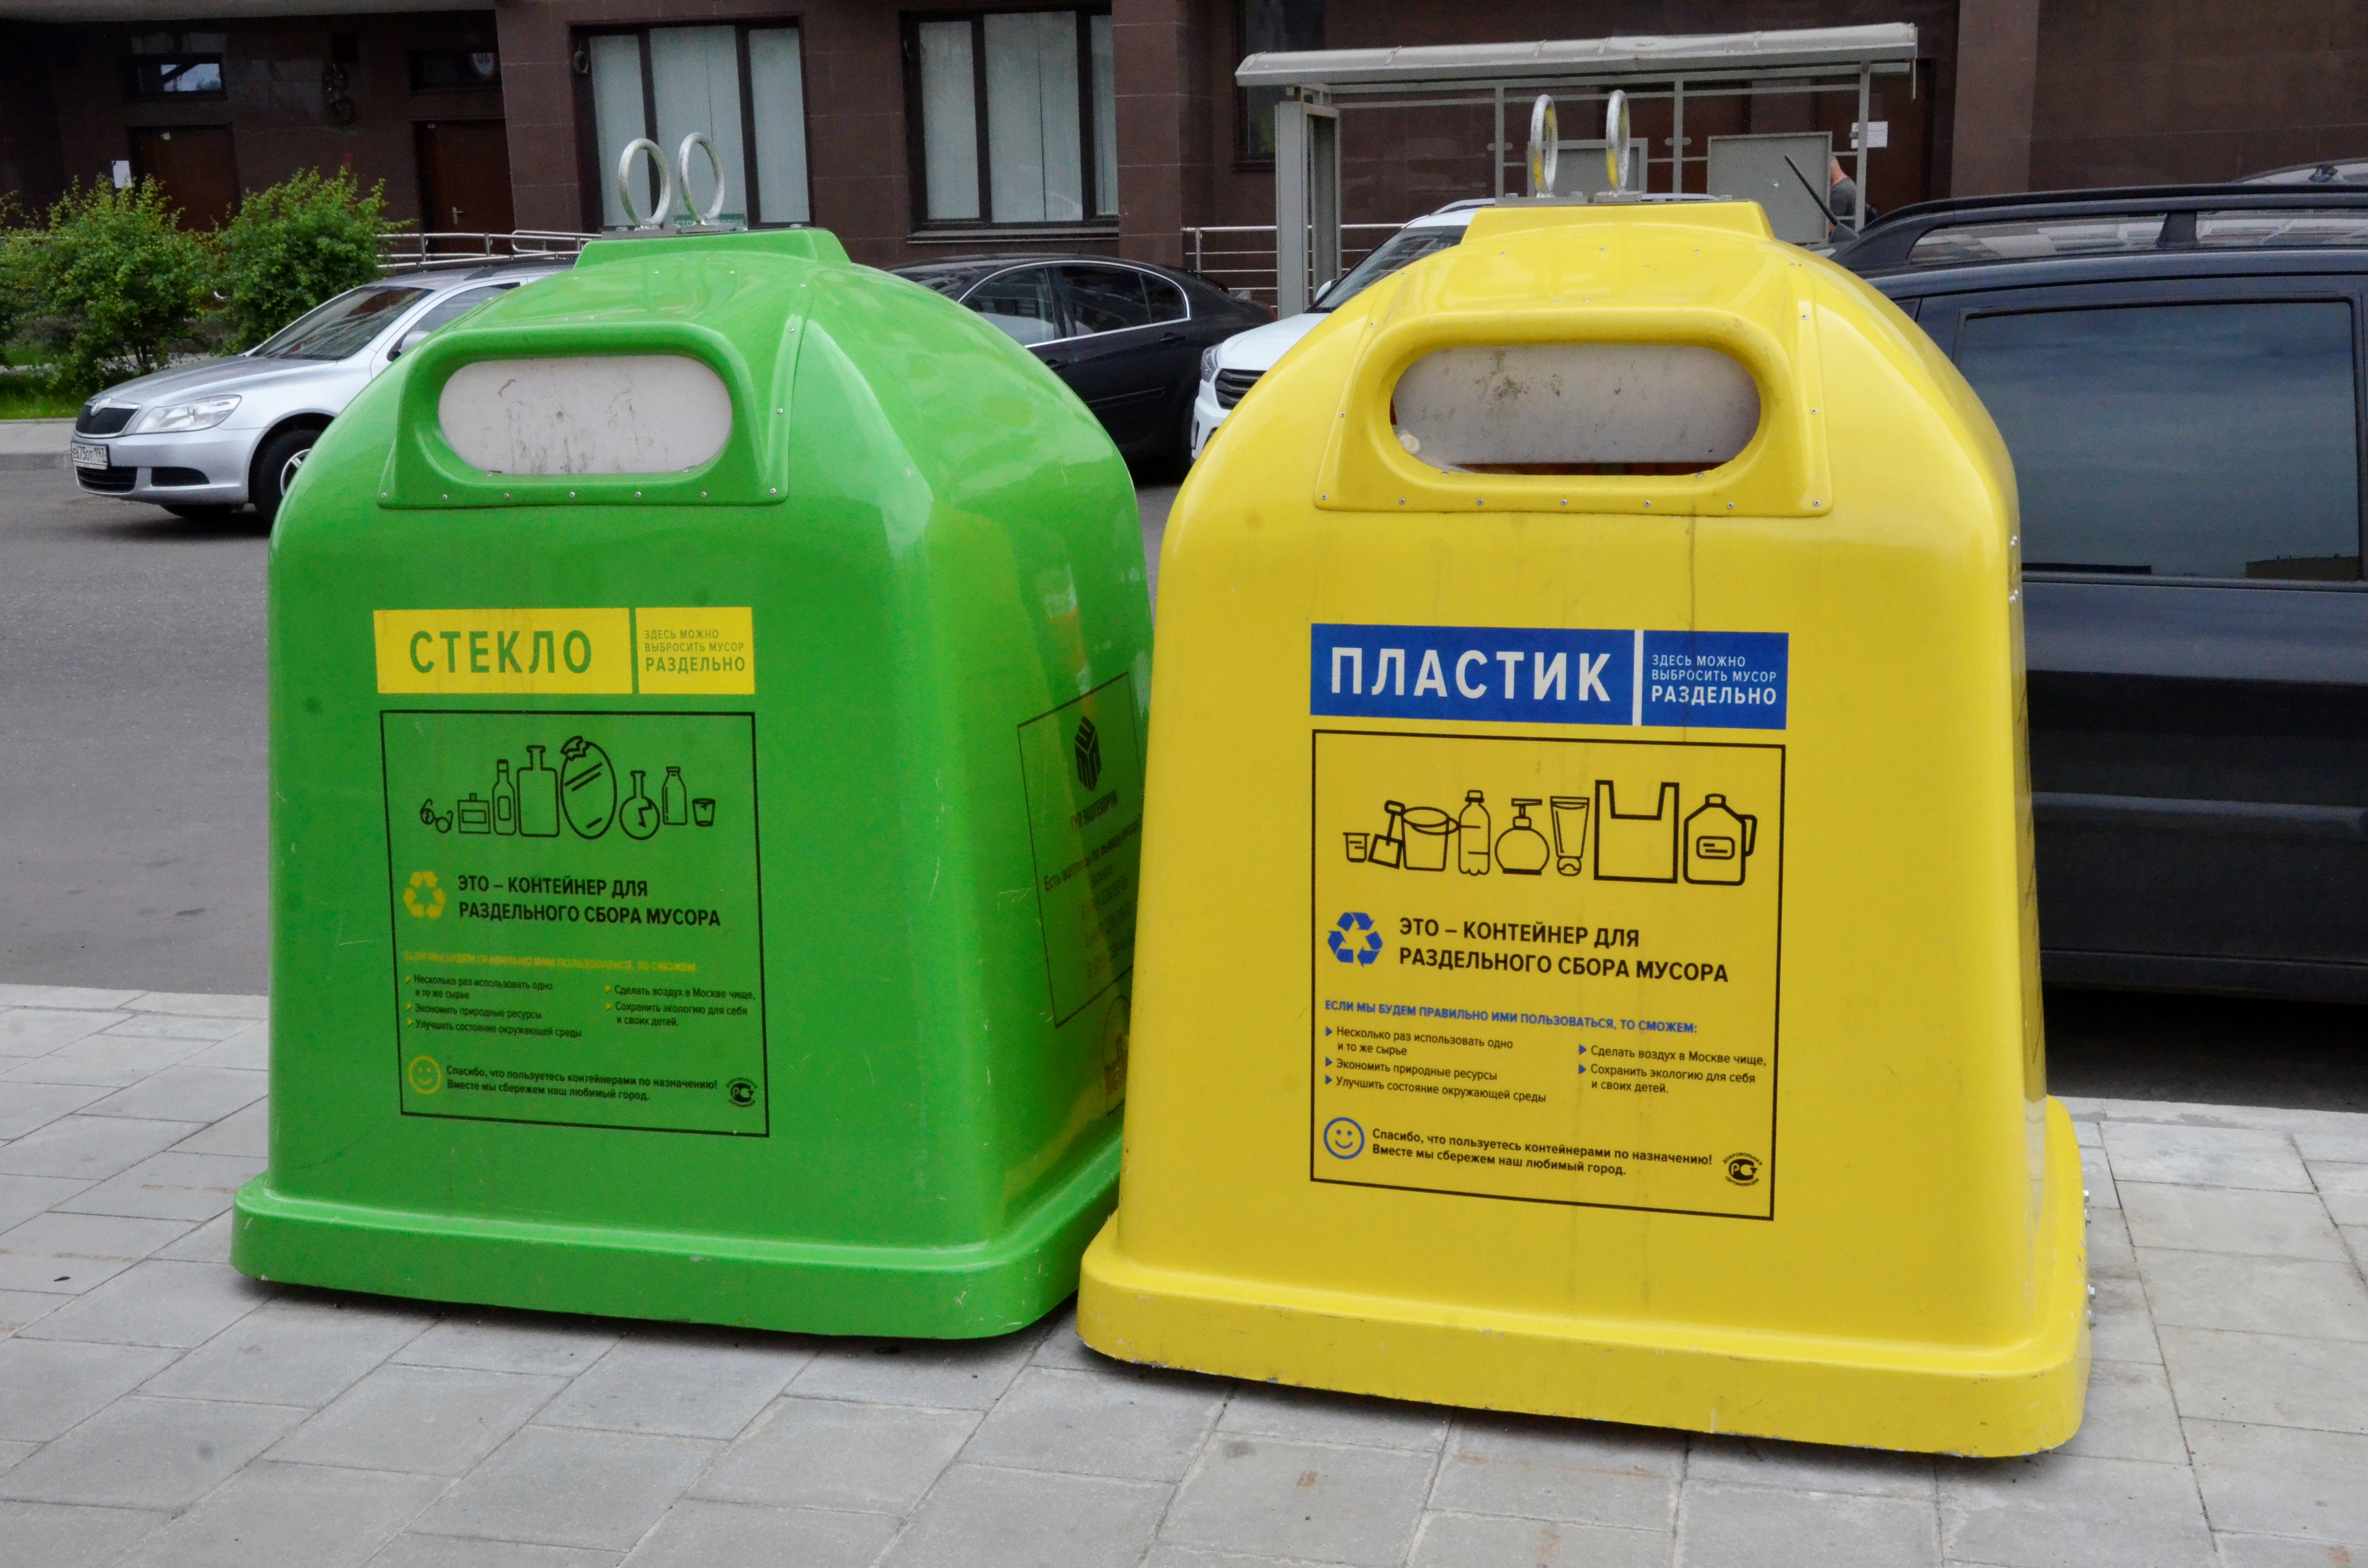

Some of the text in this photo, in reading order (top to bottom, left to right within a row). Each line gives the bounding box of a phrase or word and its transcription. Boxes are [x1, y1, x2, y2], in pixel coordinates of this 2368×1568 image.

[645, 629, 719, 640] ЗДЕСЬ МОЖНО
[409, 630, 592, 674] СТЕКЛО
[645, 642, 744, 652] ВЫБРОСИТЬ МУСОР
[646, 656, 745, 674] РАЗДЕЛЬНО
[1653, 654, 1746, 667] ЗДЕСЬ МОЖНО
[1332, 647, 1611, 702] ПЛАСТИК
[1652, 669, 1776, 682] ВЫБРОСИТЬ МУСОР
[1651, 685, 1776, 706] РАЗДЕЛЬНО
[457, 874, 489, 892] ЭТО
[508, 875, 607, 895] КОНТЕЙНЕР
[611, 879, 648, 899] ДЛЯ
[459, 901, 721, 927] РАЗДЕЛЬНОГО СБОРА МУСОРА
[1399, 917, 1439, 937] ЭТО
[1464, 921, 1588, 944] КОНТЕЙНЕР
[1593, 928, 1639, 949] ДЛЯ
[1399, 947, 1728, 982] РАЗДЕЛЬНОГО СБОРА МУСОРА
[413, 974, 553, 992] Несколько раз использовать одно
[614, 984, 651, 996] Сделать
[652, 988, 683, 998] воздух
[692, 988, 727, 998] Москве
[445, 991, 470, 1000] сырье
[415, 1003, 542, 1020] Экономить природные ресурсы
[615, 1001, 748, 1016] Сохранить экологию для себя
[1325, 1000, 1697, 1033] ЕСЛИ МЫ БУДЕМ ПРАВИЛЬНО ИМИ ПОЛЬЗОВАТЬСЯ, ТО СМОЖЕМ:
[416, 1019, 582, 1039] Улучшить состояние окружающей среды
[624, 1017, 649, 1025] своих
[1336, 1026, 1514, 1050] Несколько раз использовать одно
[1346, 1043, 1357, 1052] то
[1359, 1045, 1373, 1053] же
[1376, 1046, 1407, 1056] сырье
[1591, 1045, 1766, 1066] Сделать воздух в Москве чище,
[489, 1070, 505, 1078] что
[507, 1071, 566, 1081] пользуетесь
[567, 1074, 637, 1086] контейнерами
[638, 1078, 651, 1087] по
[1336, 1058, 1497, 1081] Экономить природные ресурсы
[1591, 1063, 1756, 1083] Сохранить экологию для себя
[447, 1078, 480, 1090] Вместе
[498, 1083, 545, 1095] сбережем
[547, 1088, 567, 1096] наш
[569, 1088, 616, 1099] любимый
[1336, 1076, 1546, 1103] Улучшить состояние окружающей среды
[1600, 1081, 1631, 1091] своих
[1634, 1083, 1668, 1093] детей.
[1372, 1128, 1712, 1165] Спасибо, что пользуетесь контейнерами по назначению!
[1372, 1143, 1626, 1176] Вместе мы сбережем наш любимый город.
